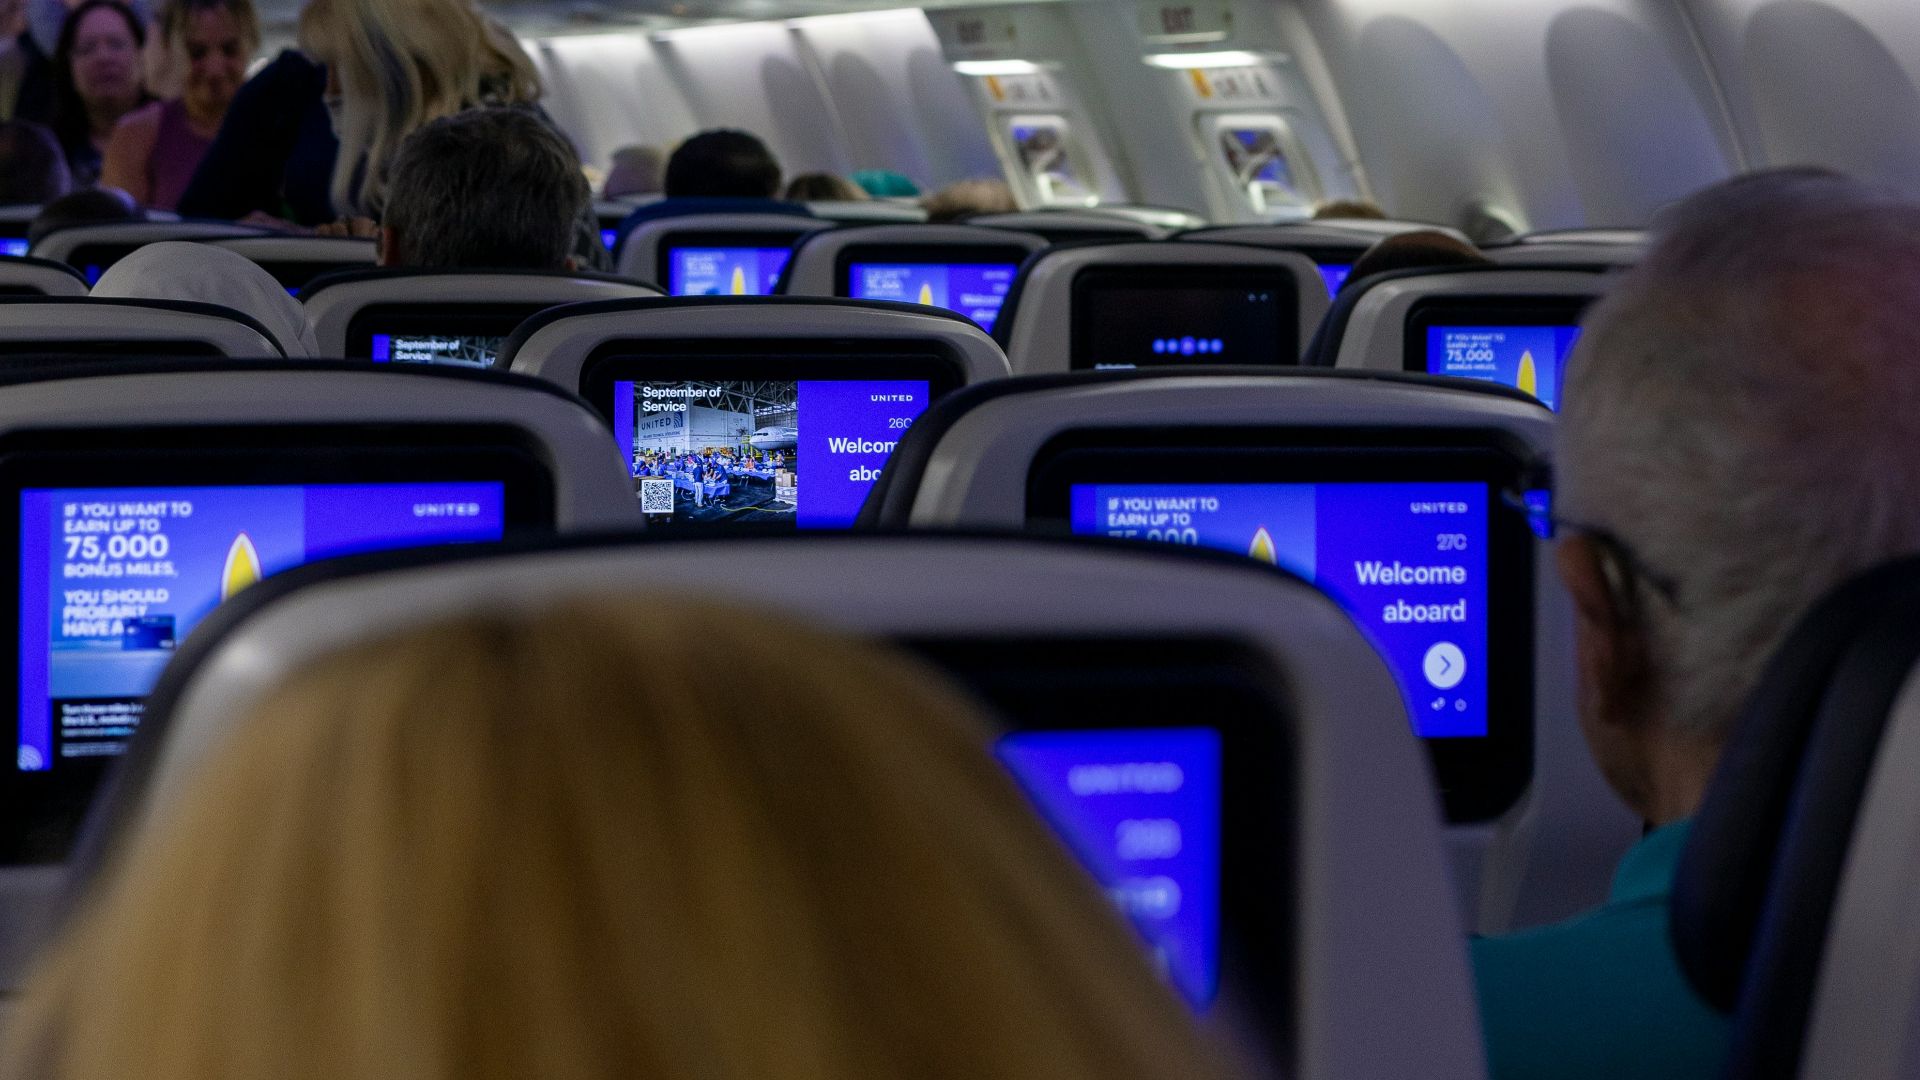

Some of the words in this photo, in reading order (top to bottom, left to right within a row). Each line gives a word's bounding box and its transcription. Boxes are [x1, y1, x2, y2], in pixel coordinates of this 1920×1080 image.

[395, 339, 448, 351] September
[449, 339, 460, 350] of
[395, 351, 432, 361] Service
[1447, 349, 1494, 364] 75,000
[642, 386, 708, 400] September
[708, 386, 722, 398] of
[870, 393, 914, 402] UNITED
[642, 400, 687, 412] Service
[641, 417, 672, 430] UNITED
[888, 417, 913, 429] 26C
[828, 437, 899, 454] Welcom
[849, 465, 882, 481] abo
[81, 502, 116, 517] YOU
[118, 501, 168, 516] WANT
[170, 501, 193, 517] TO
[413, 502, 480, 517] UNITED
[1122, 497, 1152, 511] YOU
[1153, 497, 1197, 511] WANT
[1200, 497, 1219, 511] TO
[1410, 501, 1468, 514] UNITED
[64, 518, 111, 534] EARN
[112, 518, 137, 533] UP
[138, 518, 161, 533] TO
[1107, 512, 1148, 527] EARN
[1149, 512, 1170, 526] UP
[1171, 512, 1191, 526] TO
[1107, 527, 1198, 545] 000
[1436, 533, 1467, 551] 27C
[64, 534, 169, 565] 75,000
[63, 561, 124, 578] BONUS
[1354, 560, 1467, 586] Welcome
[64, 589, 100, 605] YOU
[101, 588, 169, 604] SHOULD
[1382, 598, 1467, 623] aboard
